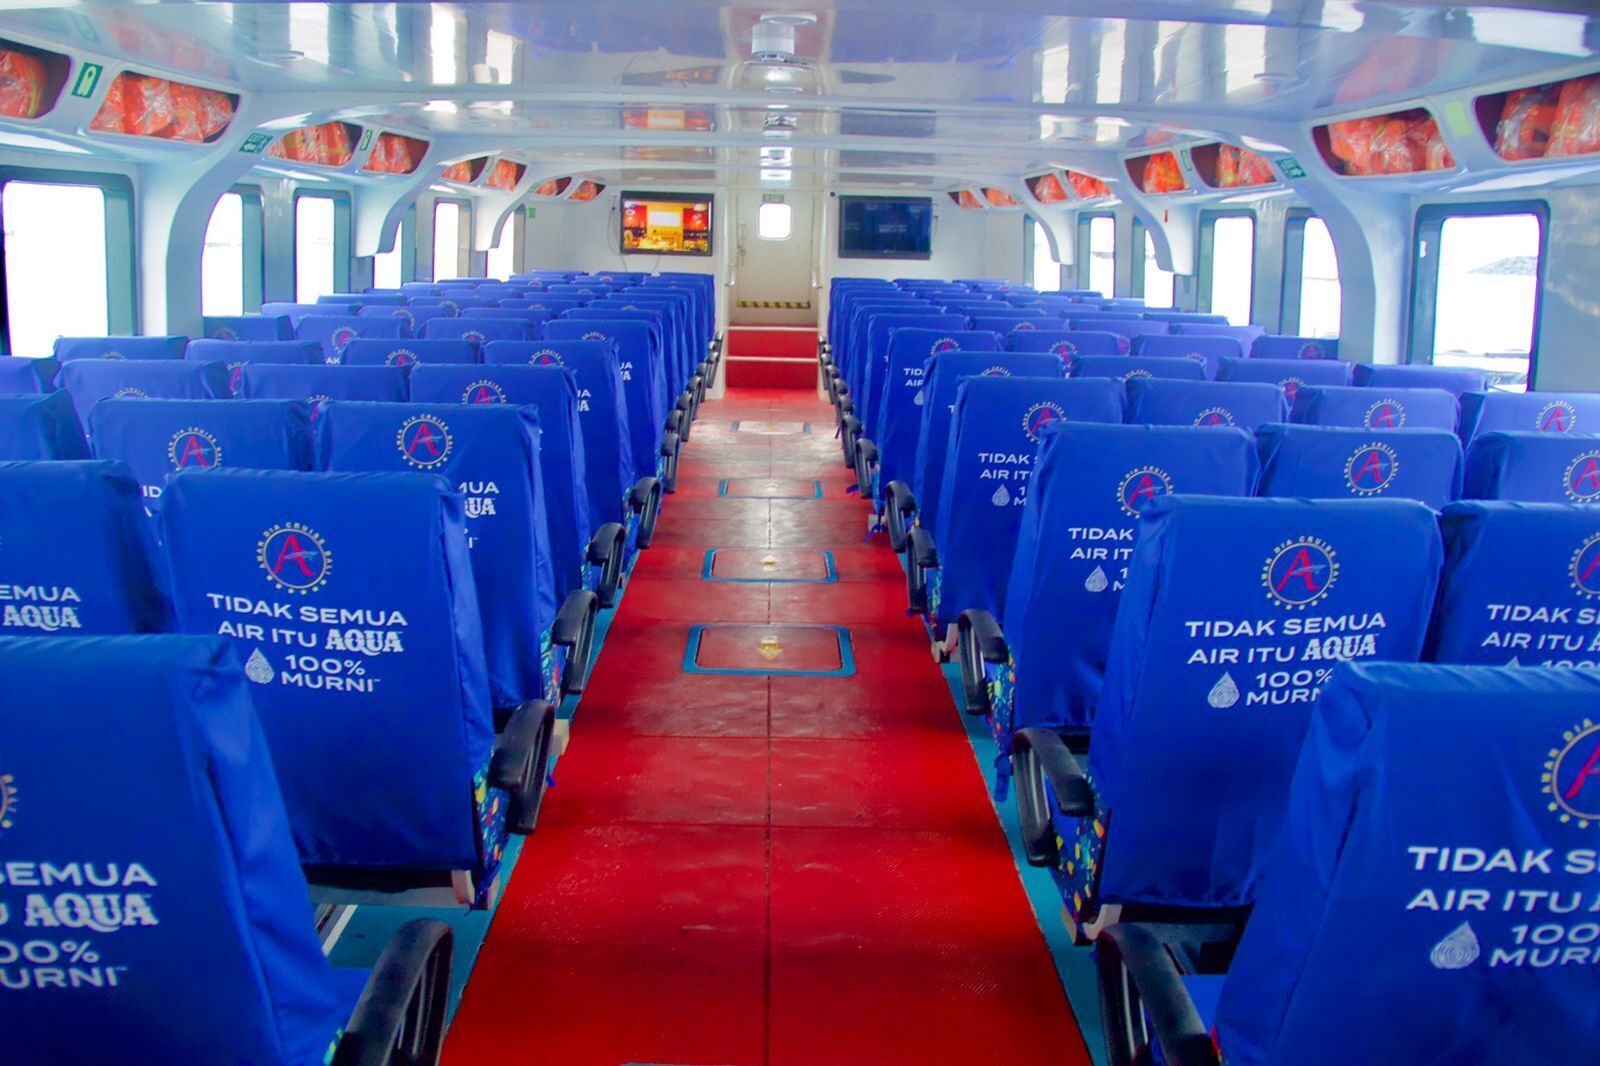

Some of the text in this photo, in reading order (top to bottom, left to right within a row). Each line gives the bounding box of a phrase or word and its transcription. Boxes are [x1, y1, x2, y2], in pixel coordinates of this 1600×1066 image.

[979, 452, 1030, 464] TIDAK
[980, 469, 1032, 480] AIR IT
[263, 524, 281, 538] DIA
[285, 521, 326, 546] CRUISE
[1068, 527, 1134, 541] TIDAK
[274, 535, 316, 577] A
[1070, 547, 1108, 560] AIR
[1273, 538, 1293, 554] DIA
[1298, 535, 1337, 558] CRUISE
[1276, 549, 1320, 592] A
[3, 605, 81, 631] AQUA
[206, 593, 407, 626] TIDAK SEMUA
[1487, 604, 1572, 623] TIDAK
[1185, 612, 1387, 638] TIDAK SEMUA
[217, 621, 404, 656] AIR ITU AQUA
[1187, 633, 1376, 664] AIR ITU AQUA
[1482, 631, 1532, 649] AIR
[1538, 634, 1584, 651] ITU
[285, 654, 365, 676] 100%
[1256, 668, 1333, 689] 100%
[1408, 847, 1553, 873] TIDAK
[0, 863, 156, 887] EMUA
[25, 893, 158, 932] AQUA
[1407, 889, 1491, 911] AIR
[1504, 891, 1582, 913] ITU
[1490, 948, 1600, 967] MUR
